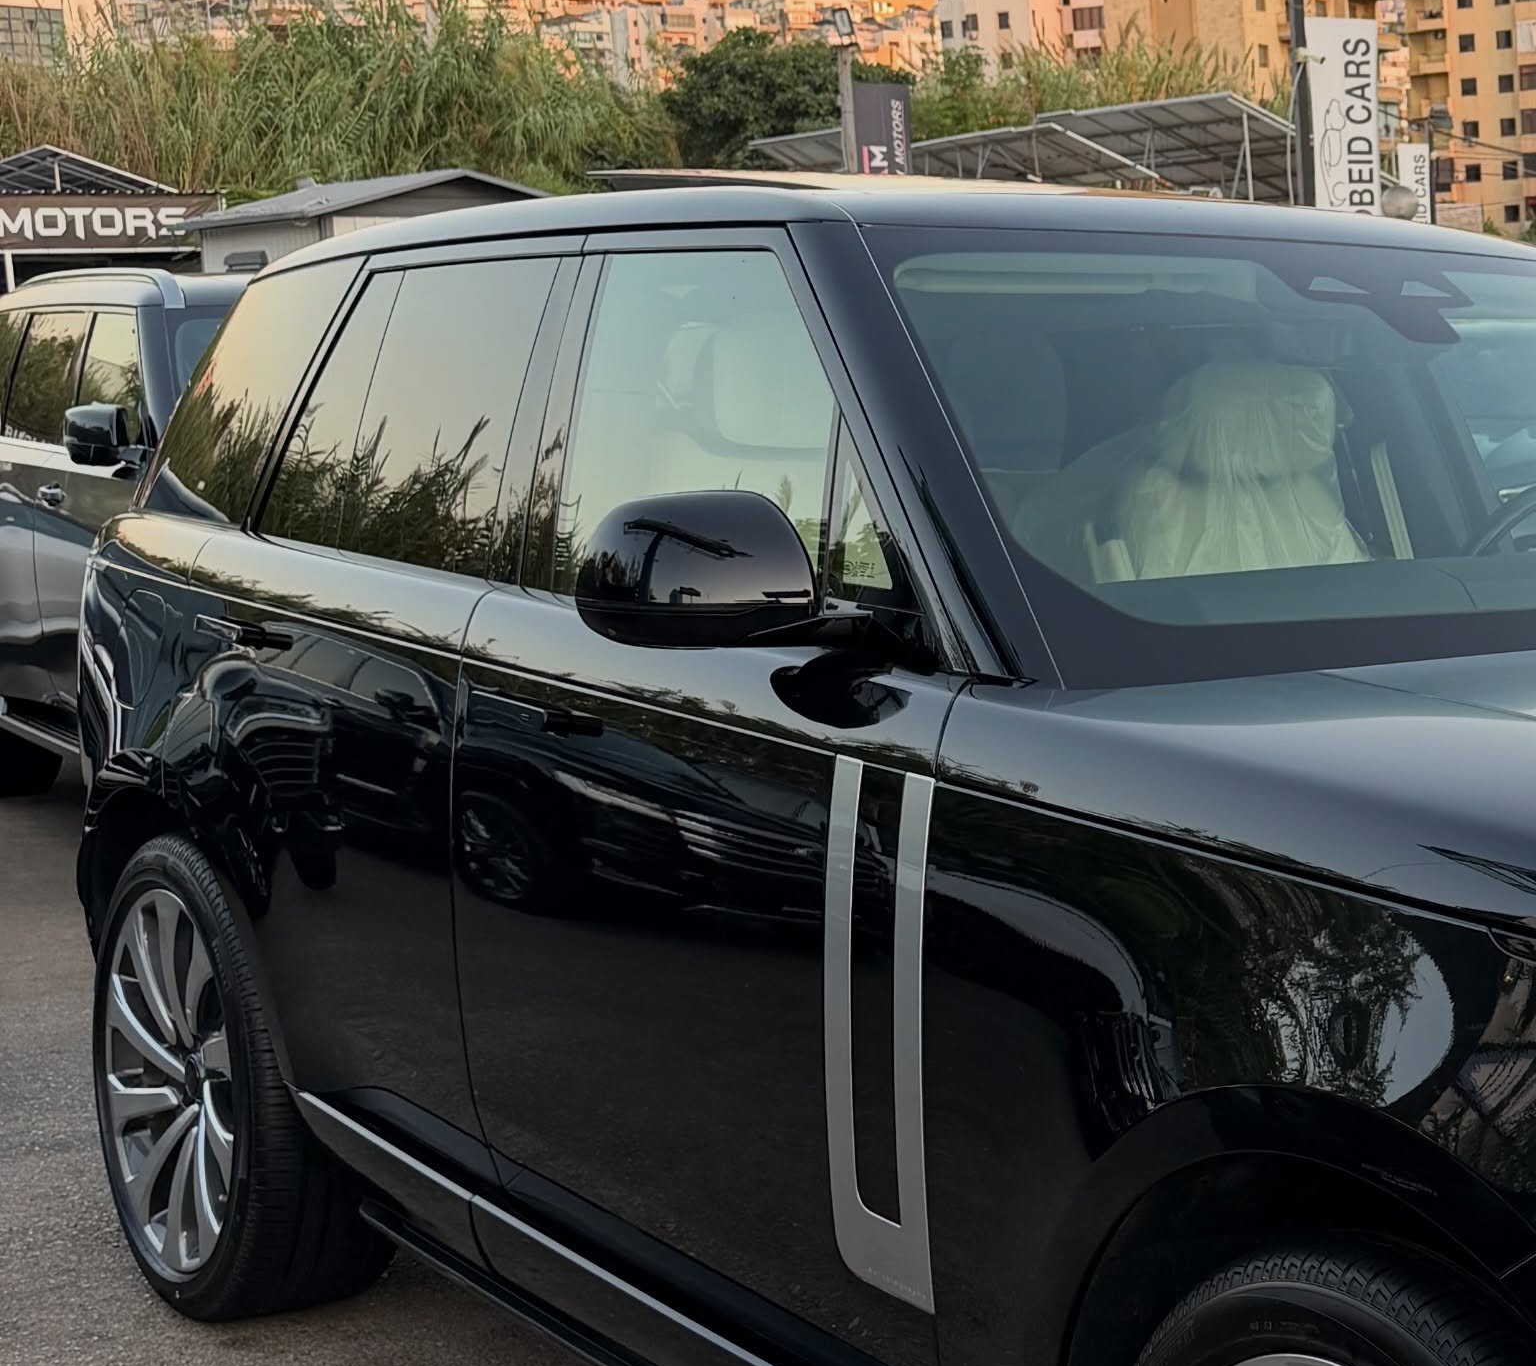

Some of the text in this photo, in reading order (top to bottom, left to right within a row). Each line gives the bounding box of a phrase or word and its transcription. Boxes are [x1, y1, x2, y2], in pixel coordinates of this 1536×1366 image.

[890, 99, 905, 165] MOTORS
[1343, 38, 1375, 215] BEID CARS
[1414, 154, 1427, 198] CARS
[0, 207, 187, 241] MOTORS
